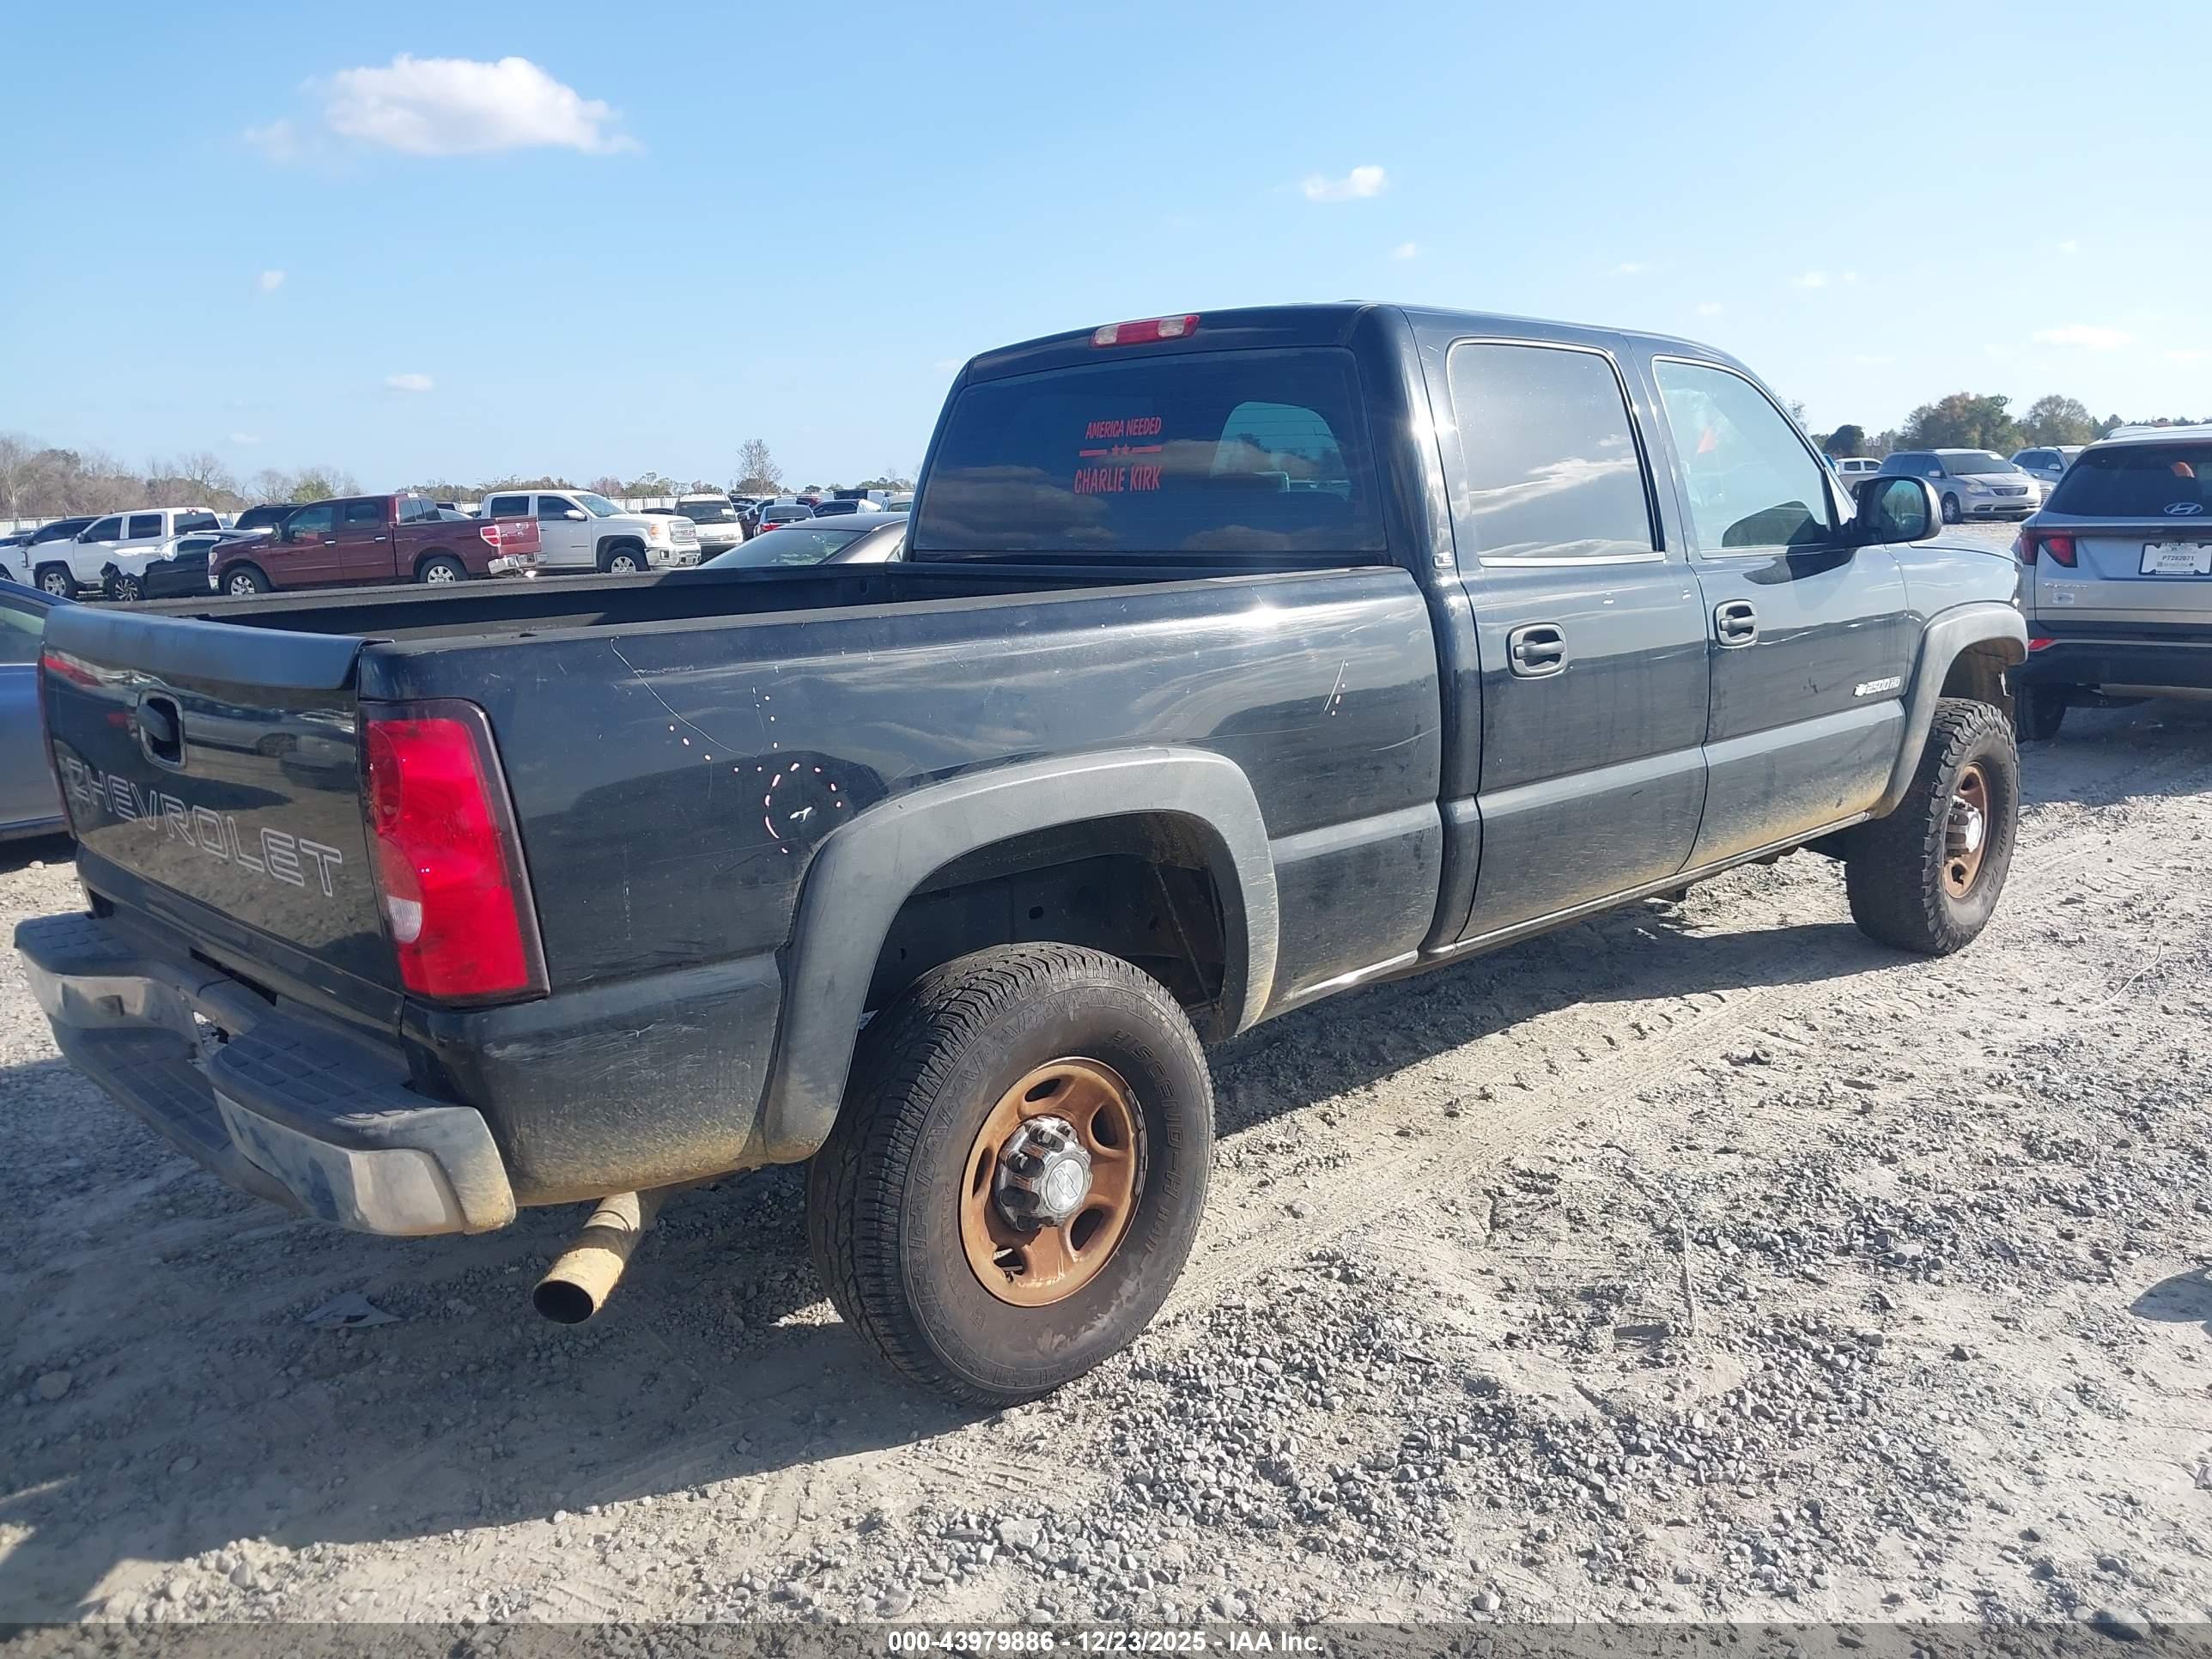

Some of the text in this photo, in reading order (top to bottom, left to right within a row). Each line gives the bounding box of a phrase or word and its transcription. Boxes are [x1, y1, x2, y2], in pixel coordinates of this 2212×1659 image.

[1085, 416, 1162, 440] AMERICA NEEDED
[1074, 465, 1162, 495] CHARLIE KIRK
[67, 757, 343, 897] CHEVROLET
